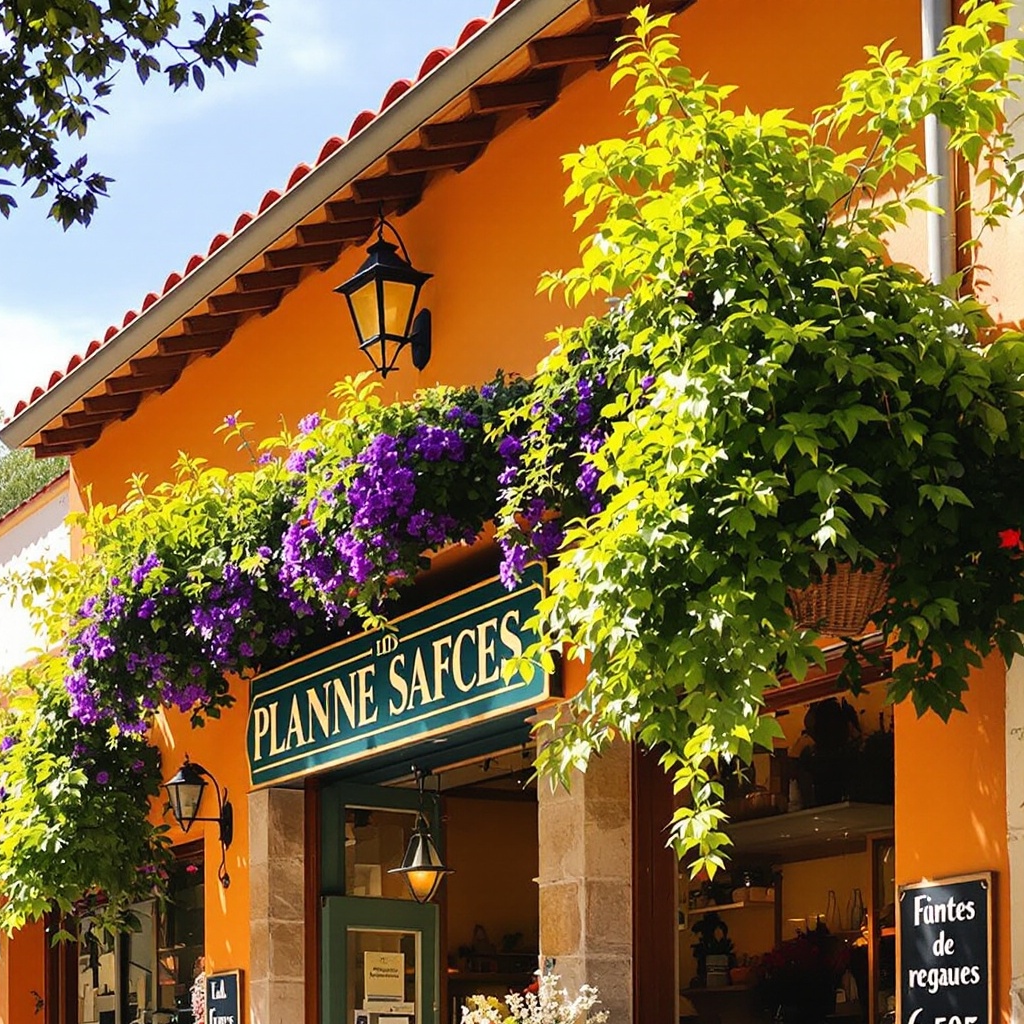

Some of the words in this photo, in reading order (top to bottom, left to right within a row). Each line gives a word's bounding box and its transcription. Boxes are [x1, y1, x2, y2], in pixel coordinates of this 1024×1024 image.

[253, 663, 378, 762] PLANNE
[388, 609, 524, 717] SAFCES
[932, 930, 955, 956] de
[908, 966, 980, 994] regaues
